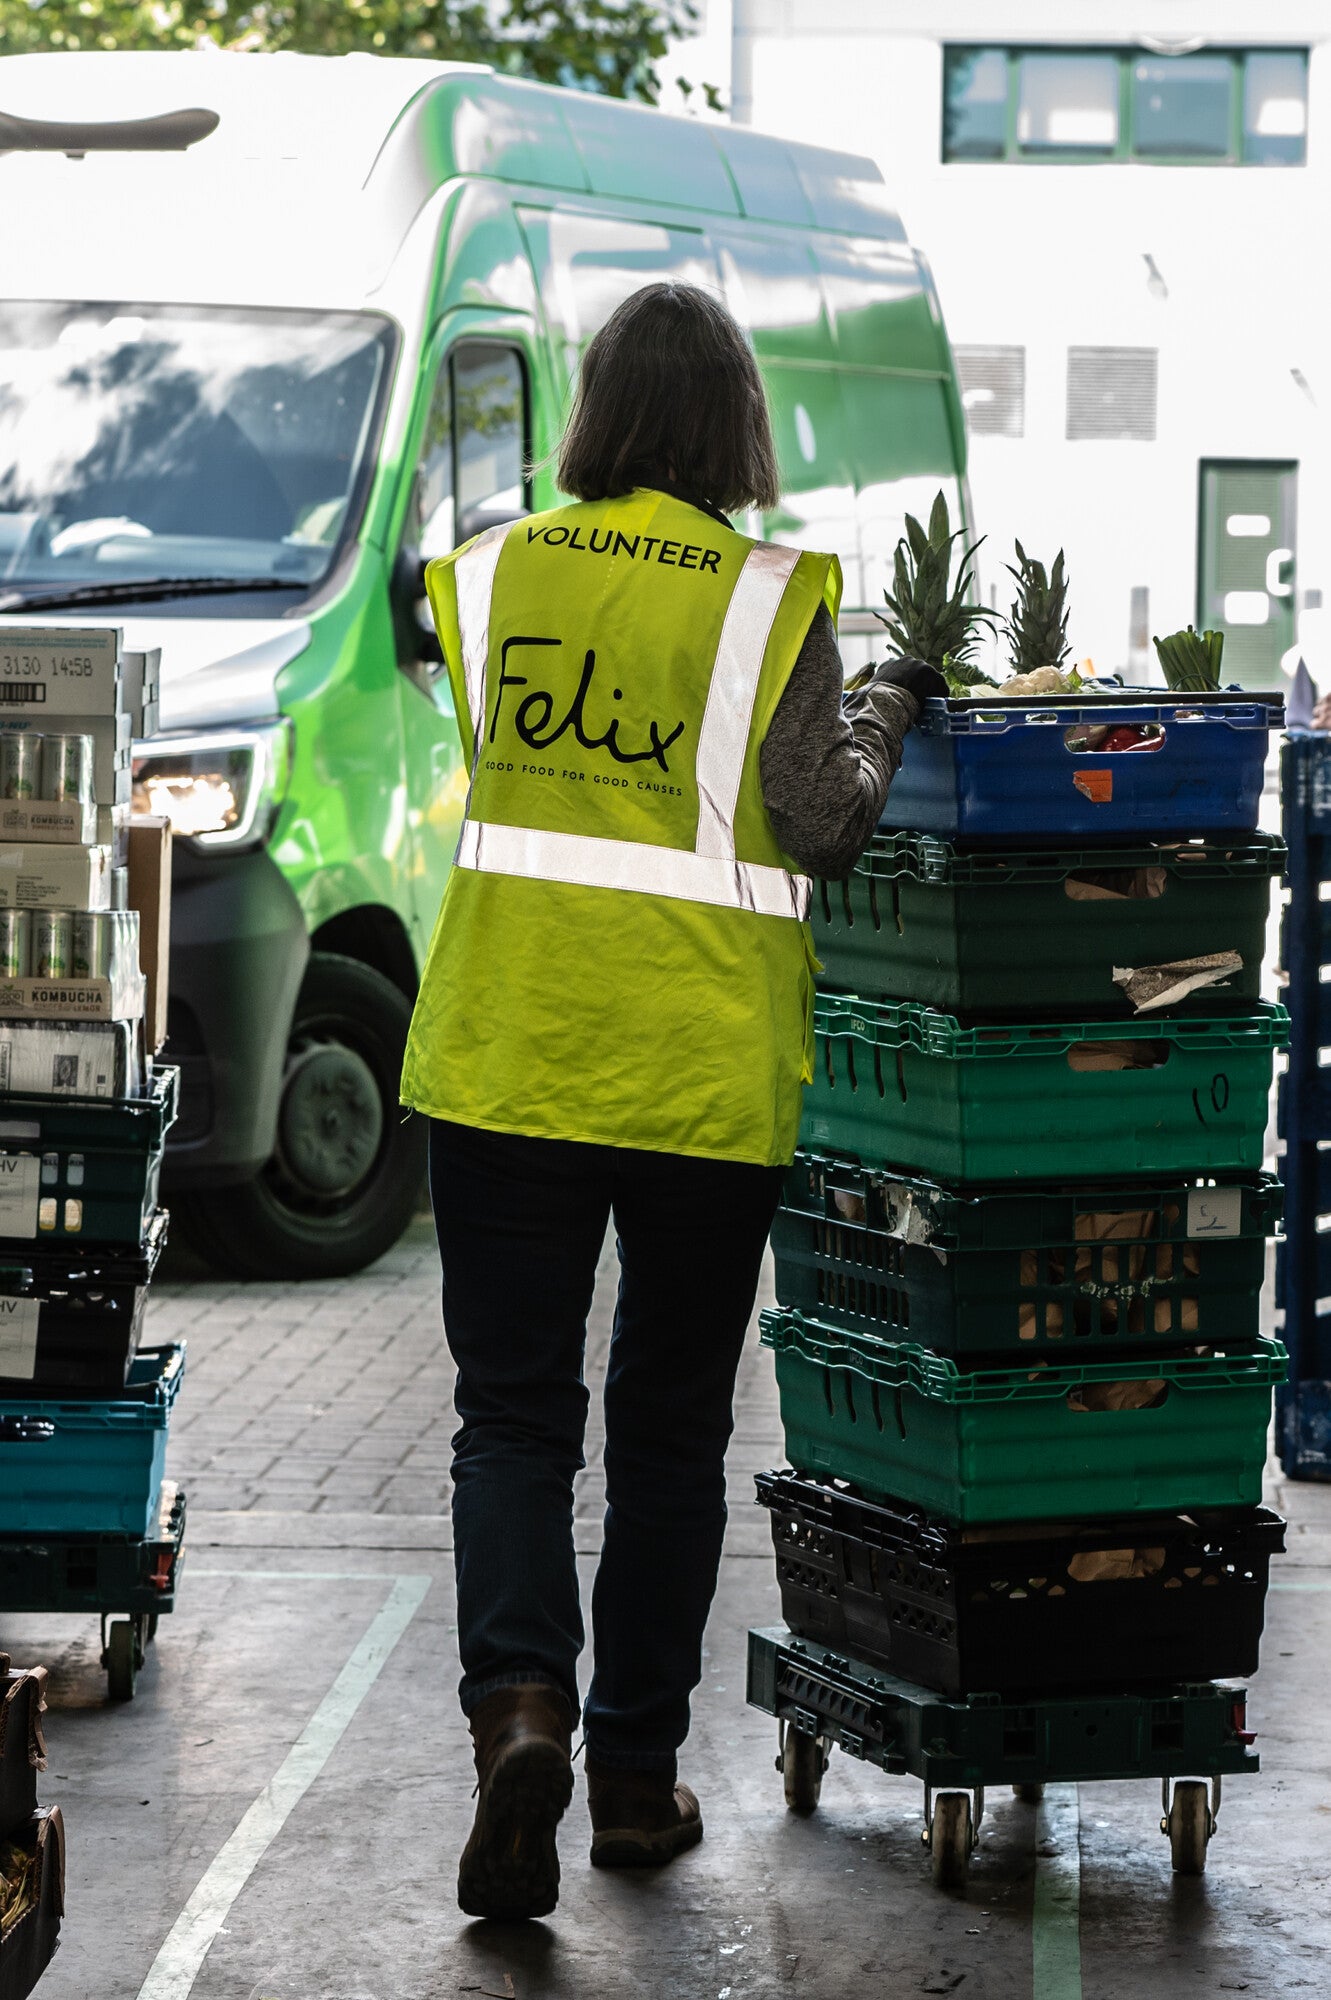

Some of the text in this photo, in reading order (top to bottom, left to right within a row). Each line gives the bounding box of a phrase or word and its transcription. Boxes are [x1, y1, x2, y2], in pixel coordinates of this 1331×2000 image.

[527, 526, 722, 574] VOLUNTEER
[3, 656, 93, 677] 3130 14:58
[489, 635, 685, 773] Felix
[485, 761, 682, 797] GOOD FOOD FOR GOOD CAUSES
[31, 816, 75, 825] KOMBUCHA
[32, 990, 103, 1003] KOMBUCHA
[850, 1018, 866, 1032] IFCO
